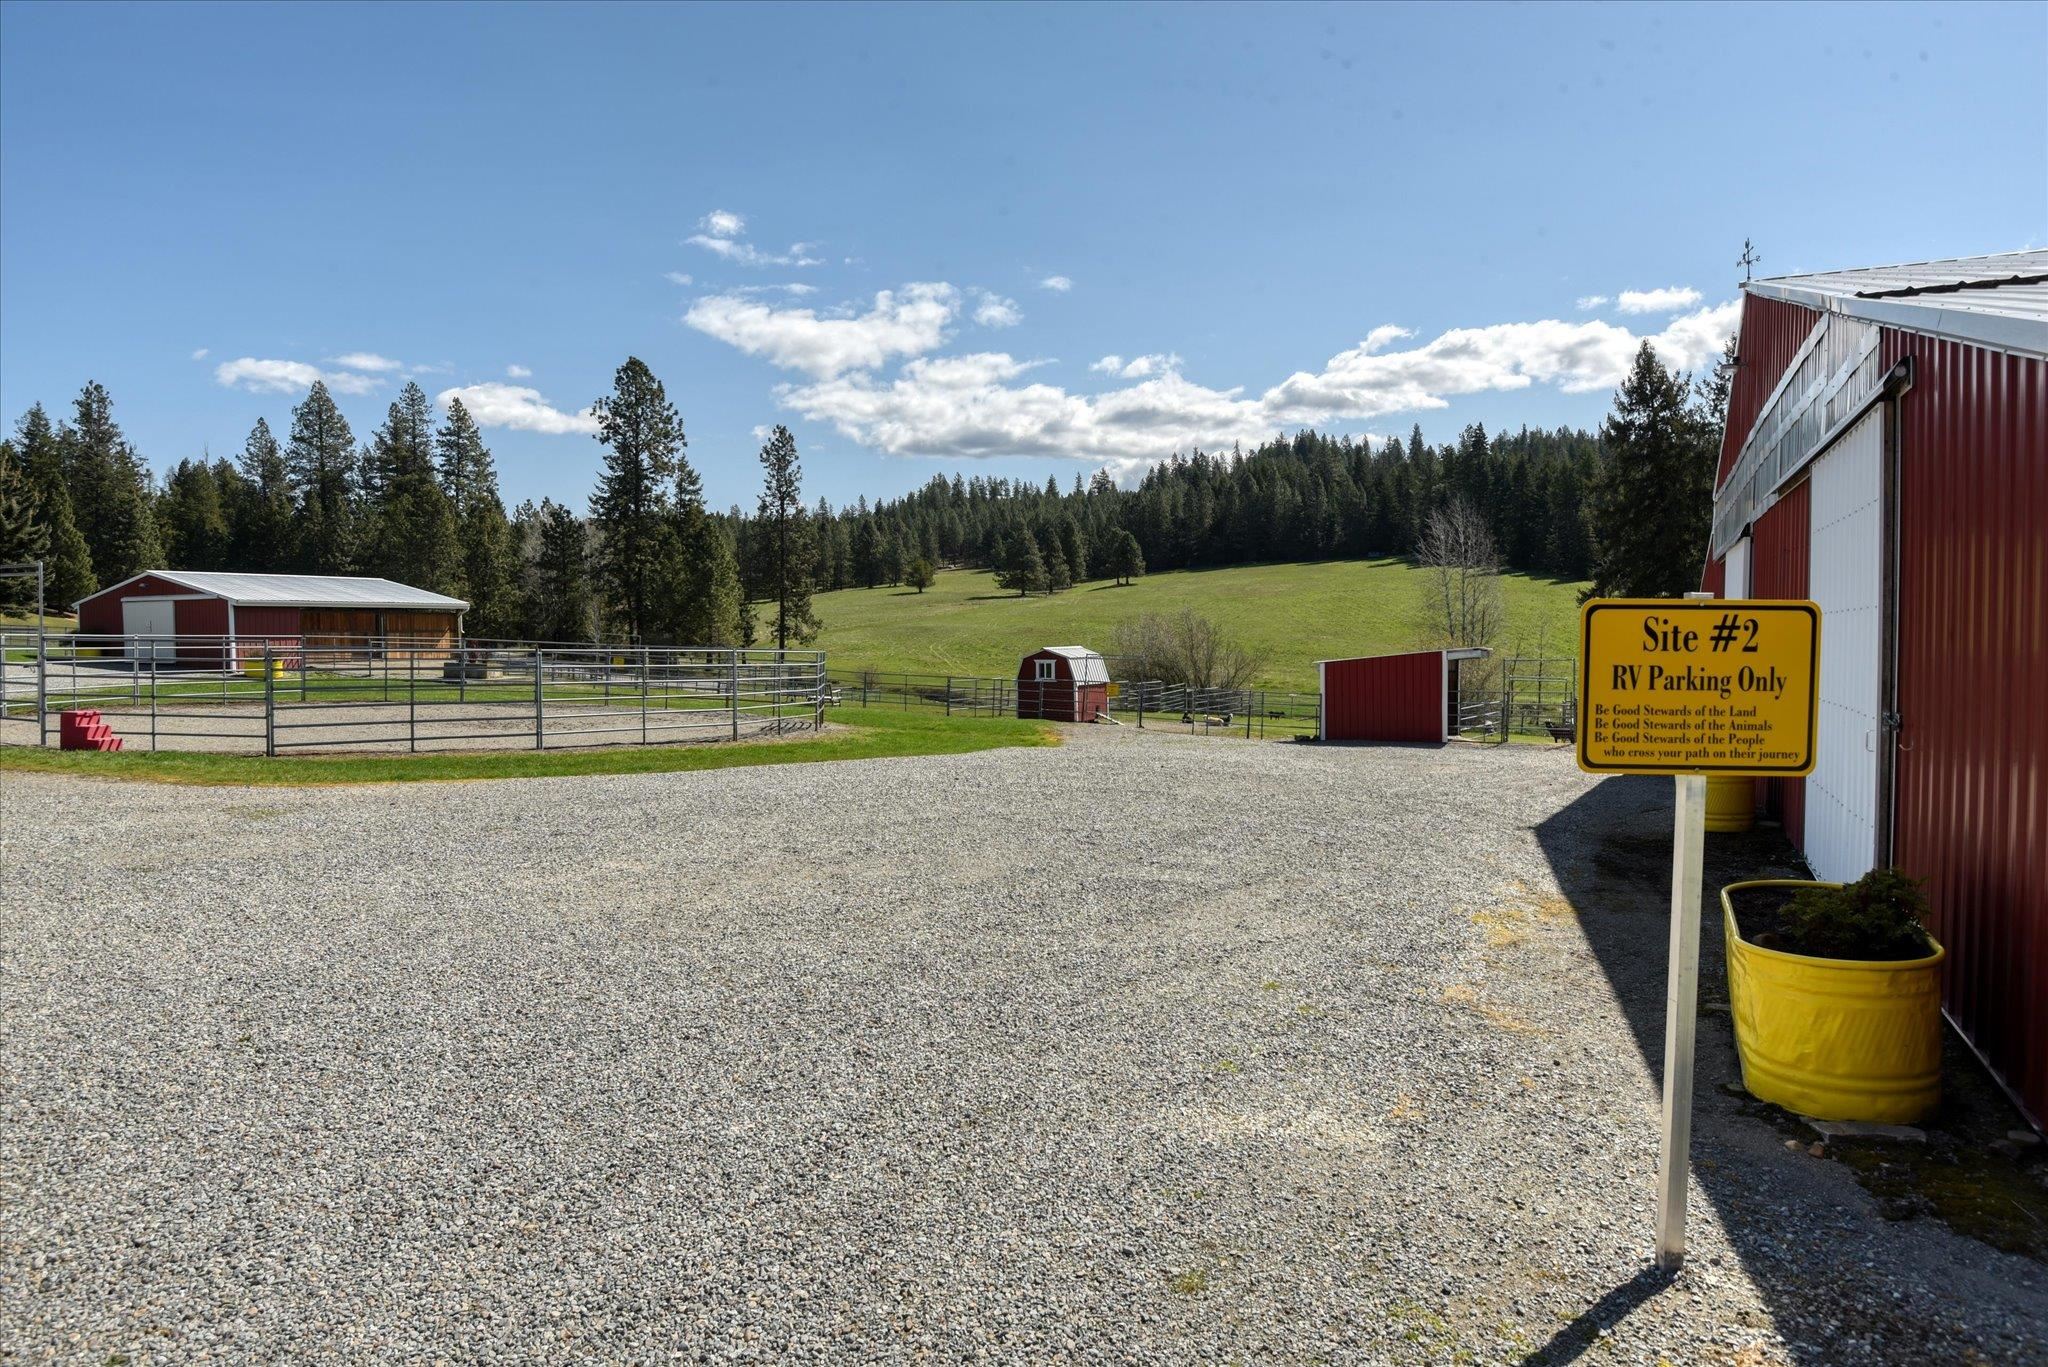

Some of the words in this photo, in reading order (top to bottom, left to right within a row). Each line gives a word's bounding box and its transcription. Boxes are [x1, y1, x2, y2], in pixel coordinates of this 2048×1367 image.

[1643, 616, 1698, 652] Site
[1710, 614, 1758, 652] #2
[1612, 665, 1641, 690] RV
[1648, 665, 1732, 699] Parking
[1738, 666, 1786, 700] Only
[1595, 704, 1610, 715] Be
[1612, 704, 1640, 716] Good
[1643, 705, 1692, 716] Stewards
[1695, 705, 1706, 717] of
[1708, 705, 1726, 717] the
[1729, 705, 1756, 717] Land
[1595, 717, 1609, 729] Be
[1612, 718, 1640, 730] Good
[1643, 718, 1692, 730] Stewards
[1694, 719, 1706, 730] of
[1708, 719, 1726, 731] the
[1730, 720, 1772, 731] Animals
[1594, 731, 1608, 743] Be
[1612, 731, 1640, 743] Good
[1643, 732, 1691, 744] Stewards
[1693, 733, 1706, 744] of
[1708, 733, 1725, 744] the
[1728, 733, 1765, 747] People
[1604, 747, 1625, 757] who
[1657, 750, 1682, 760] your
[1685, 747, 1710, 761] path
[1730, 748, 1756, 759] their
[1757, 749, 1800, 762] journey
